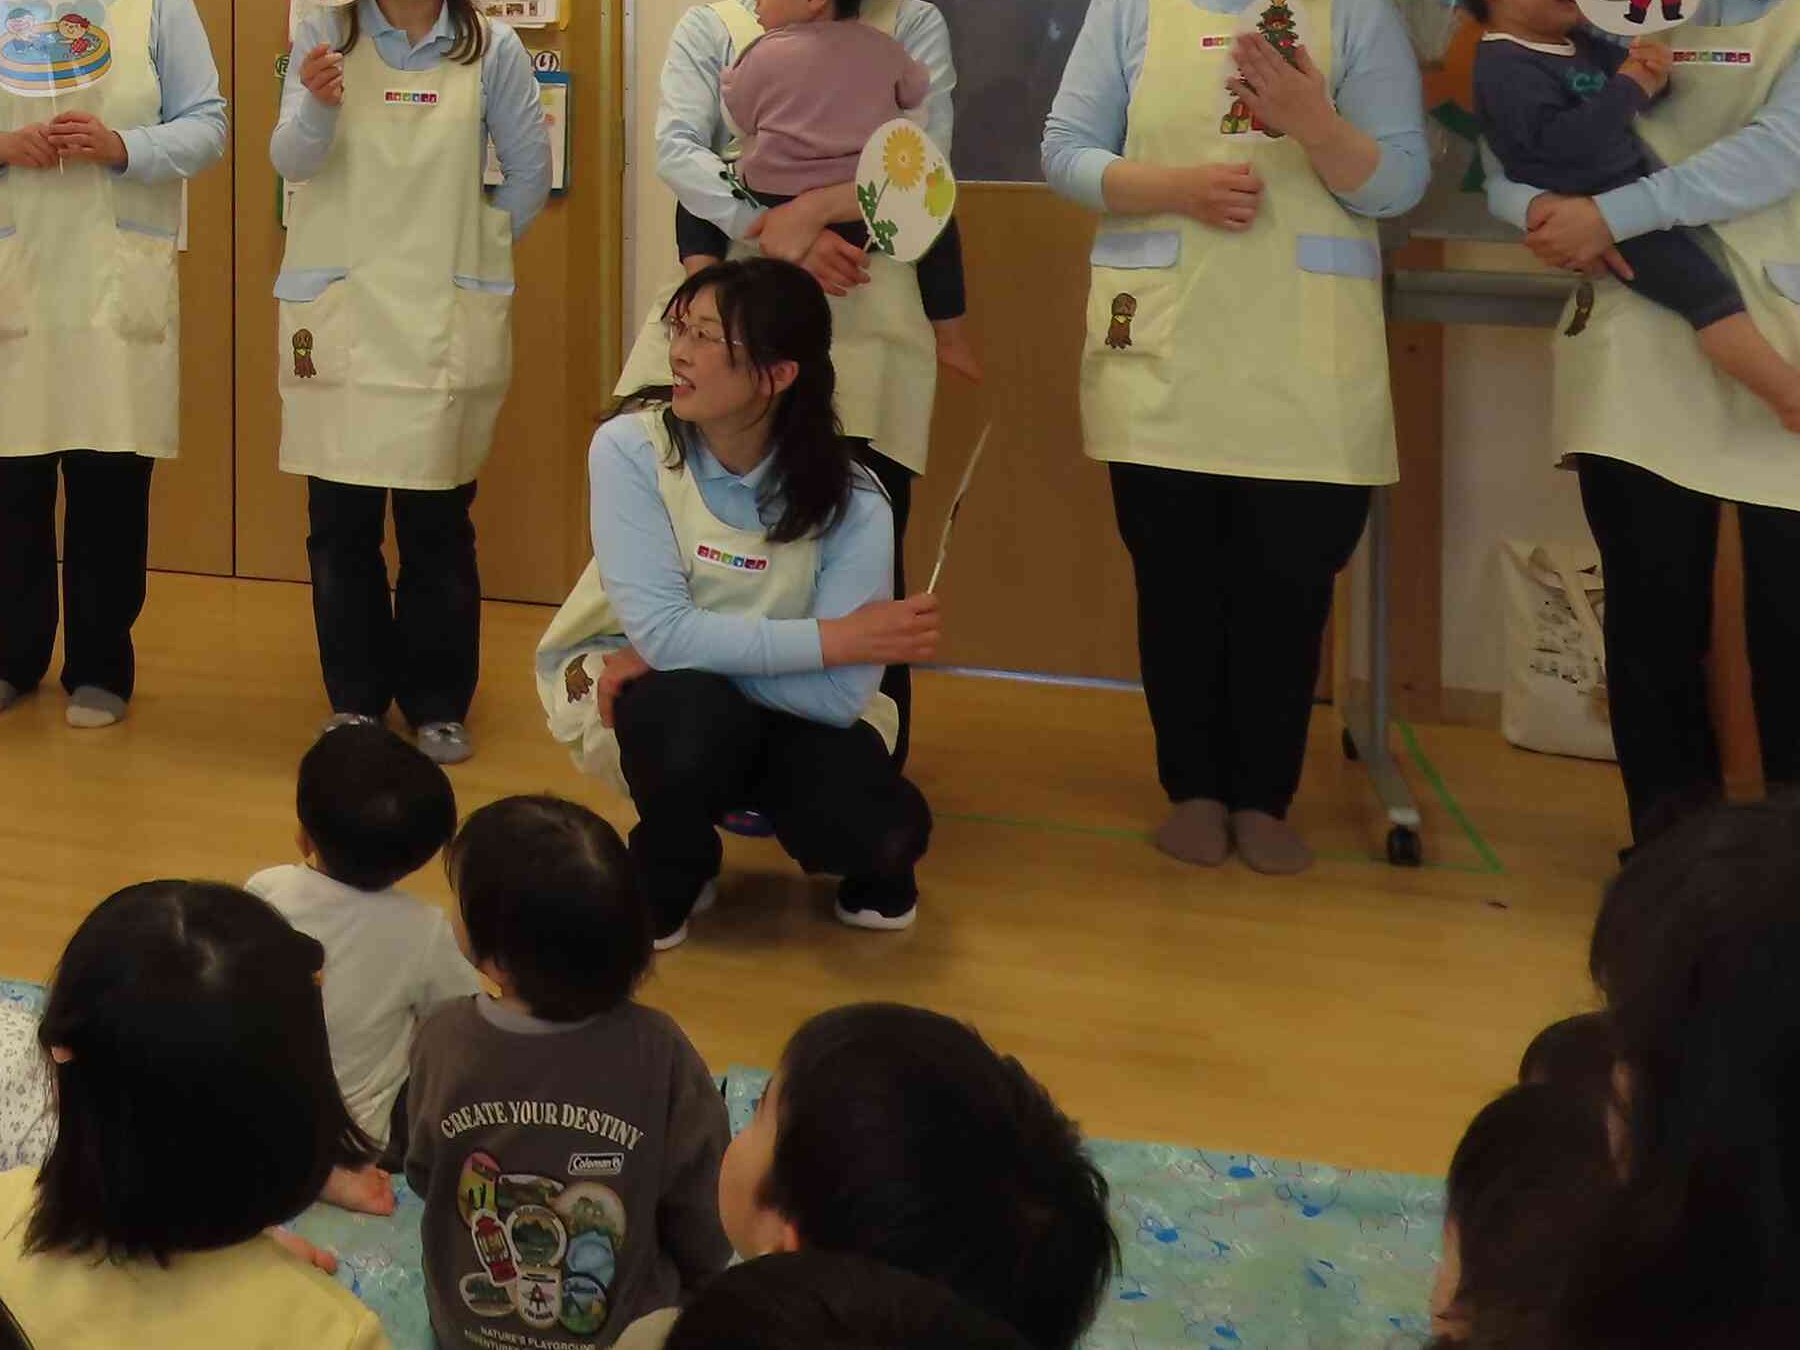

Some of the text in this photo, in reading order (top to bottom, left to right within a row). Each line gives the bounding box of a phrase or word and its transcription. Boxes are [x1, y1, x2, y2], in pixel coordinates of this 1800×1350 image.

[441, 1100, 644, 1150] CREATE YOUR DESTINY
